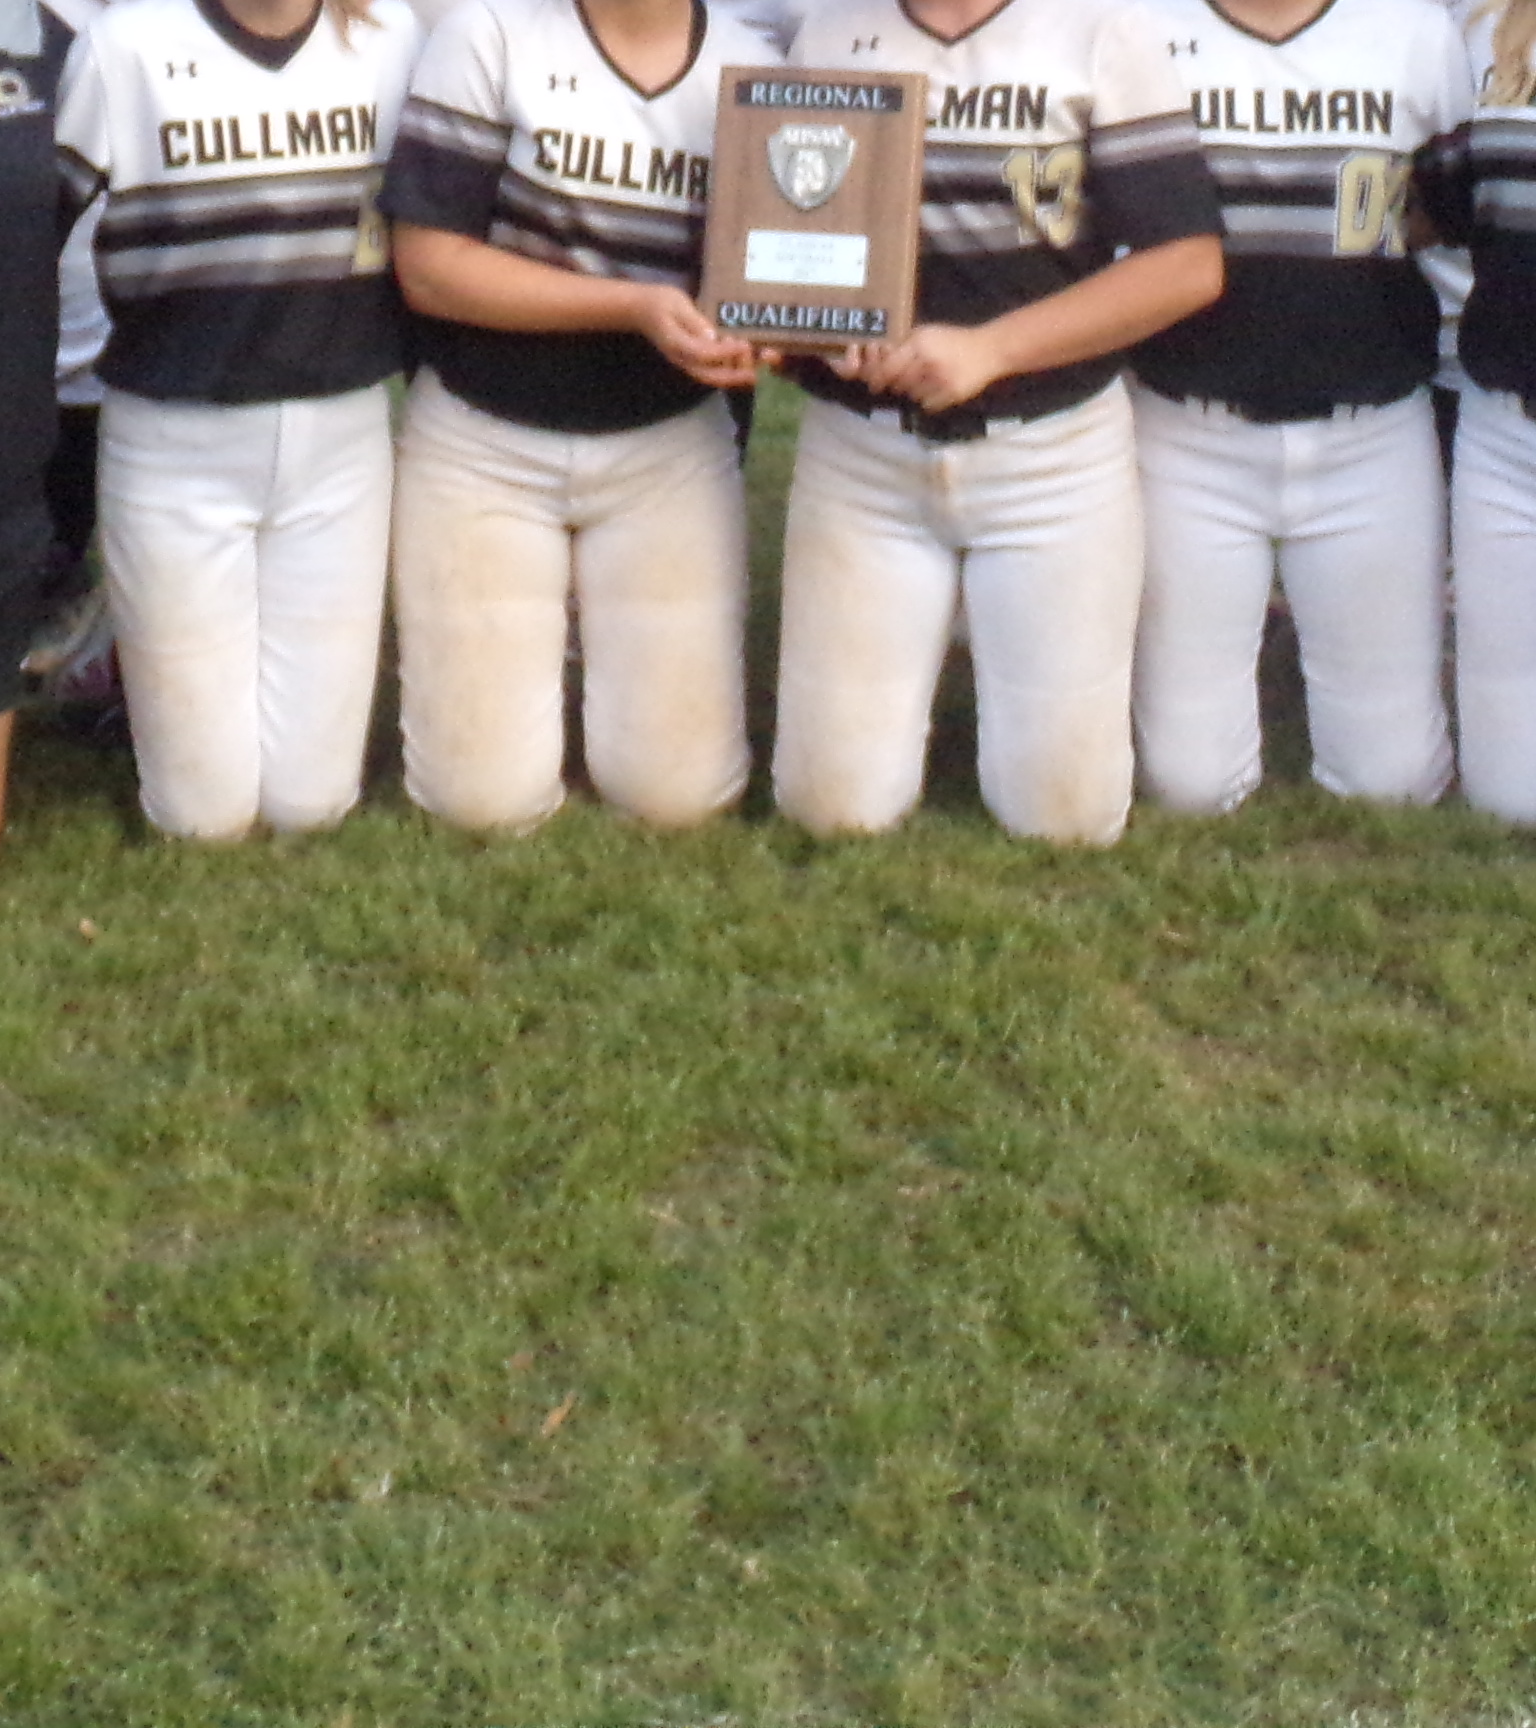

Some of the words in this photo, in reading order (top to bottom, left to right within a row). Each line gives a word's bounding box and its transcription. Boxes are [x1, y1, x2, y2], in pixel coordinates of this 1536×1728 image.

[750, 82, 888, 110] REGIONAL
[1191, 88, 1393, 134] ULLMAN
[159, 104, 377, 168] CULLMAN
[532, 127, 710, 202] CULLMA
[720, 303, 865, 330] QUALIFIER
[869, 308, 886, 332] 2
